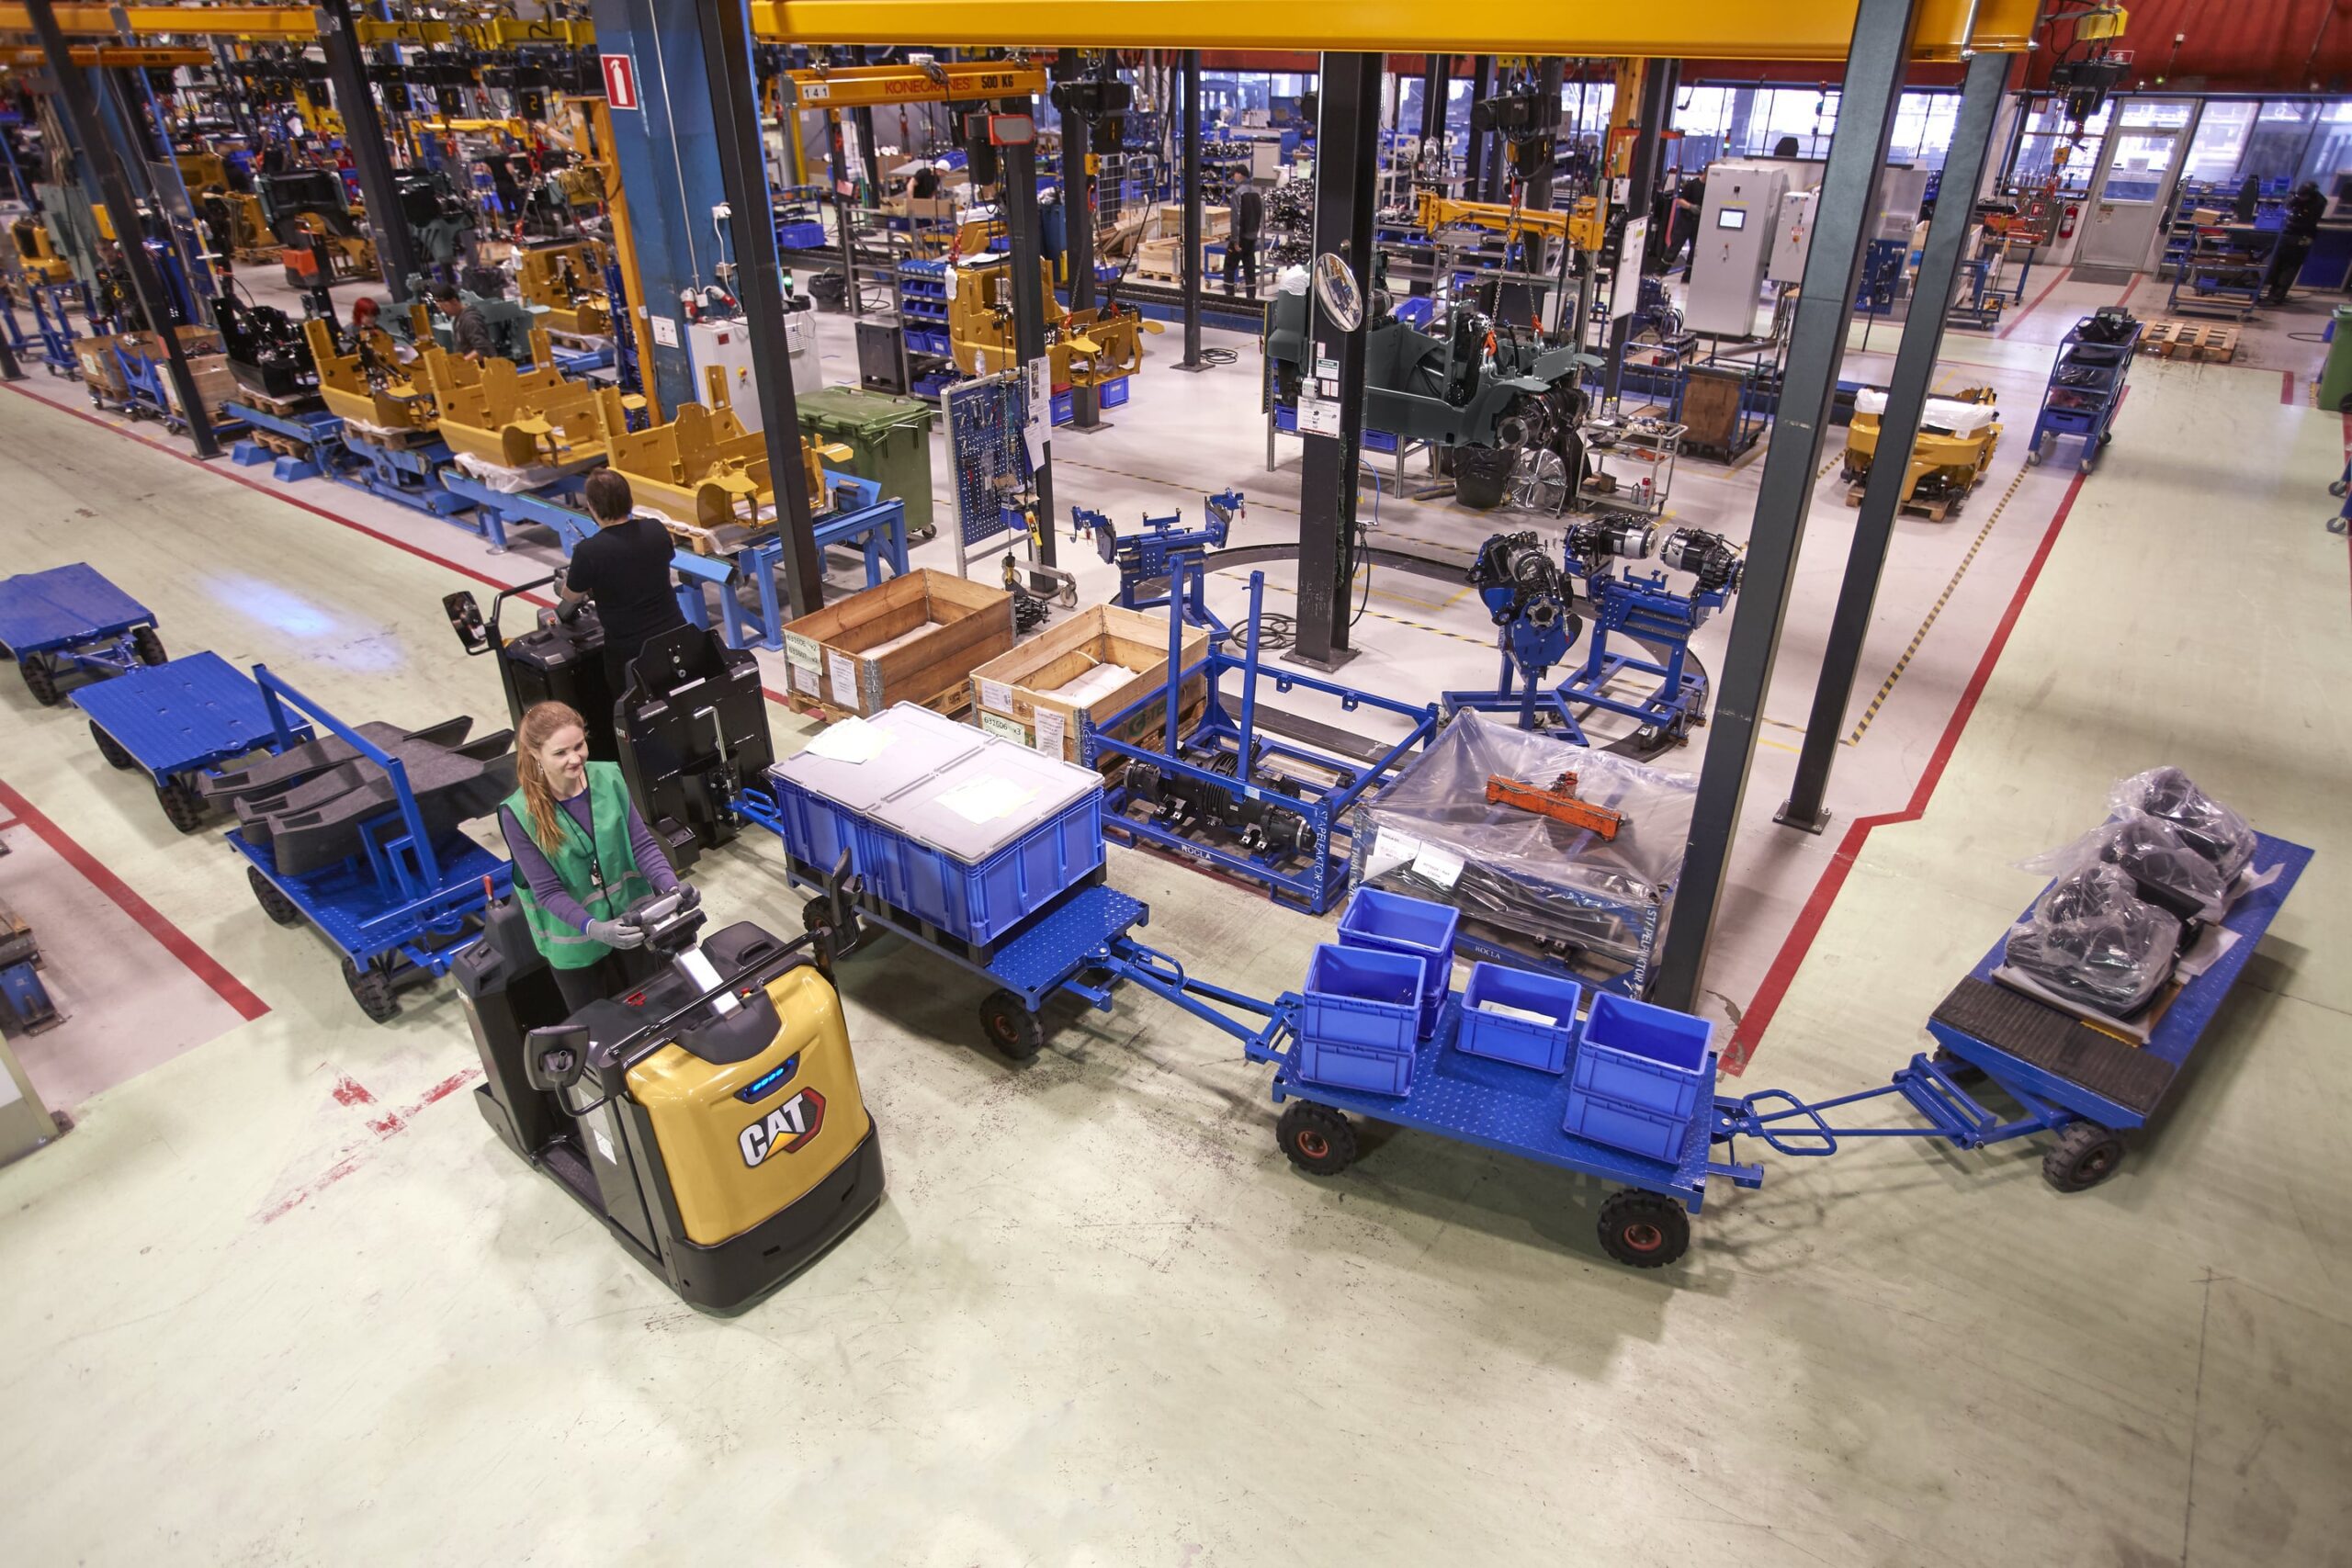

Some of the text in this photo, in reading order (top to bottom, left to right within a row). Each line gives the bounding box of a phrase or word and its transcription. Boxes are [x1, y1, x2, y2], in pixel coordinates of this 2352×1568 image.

[981, 76, 998, 89] 500
[1002, 74, 1014, 88] KG
[984, 716, 1008, 730] 631606
[1181, 844, 1212, 861] ROCLA
[1475, 945, 1500, 960] ROCLA
[740, 1092, 807, 1167] CAT
